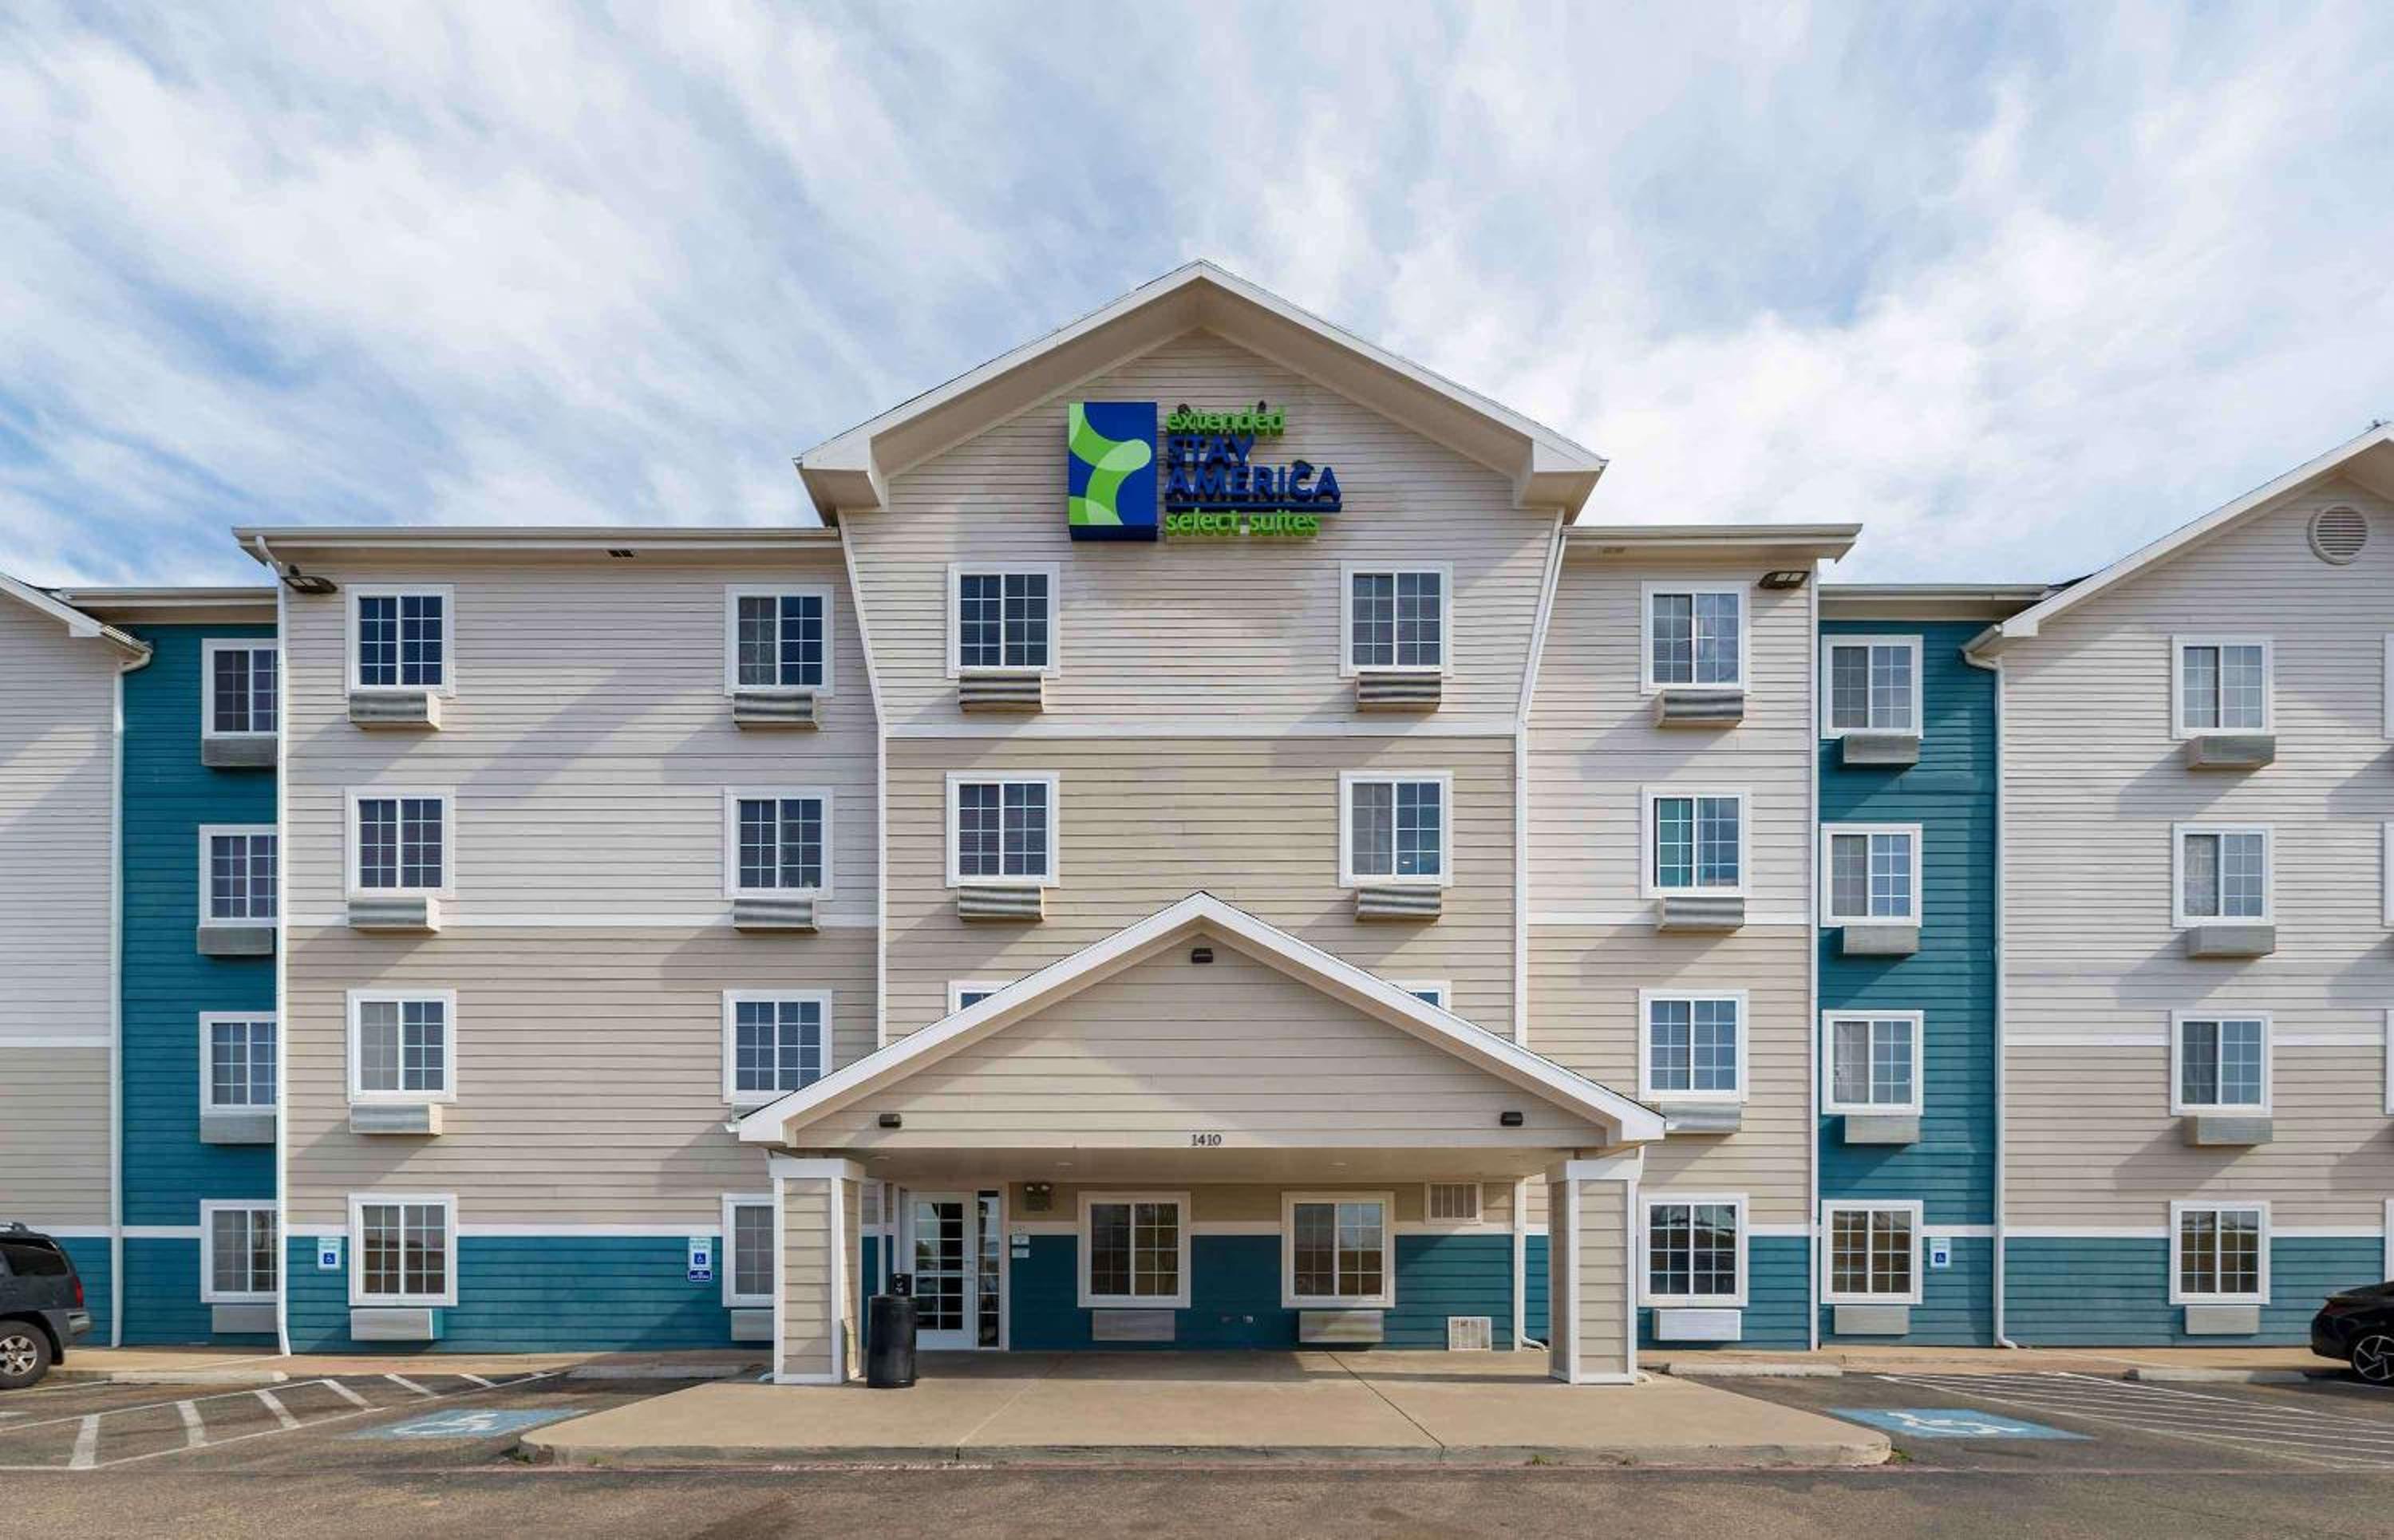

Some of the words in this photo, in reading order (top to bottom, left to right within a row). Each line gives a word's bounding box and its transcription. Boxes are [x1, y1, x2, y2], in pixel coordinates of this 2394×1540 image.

[1167, 403, 1285, 432] extended
[1167, 434, 1254, 469] STAY
[1166, 464, 1341, 503] AMERICA
[1166, 508, 1240, 534] select
[1250, 509, 1319, 534] suites
[1191, 1134, 1222, 1146] 1410
